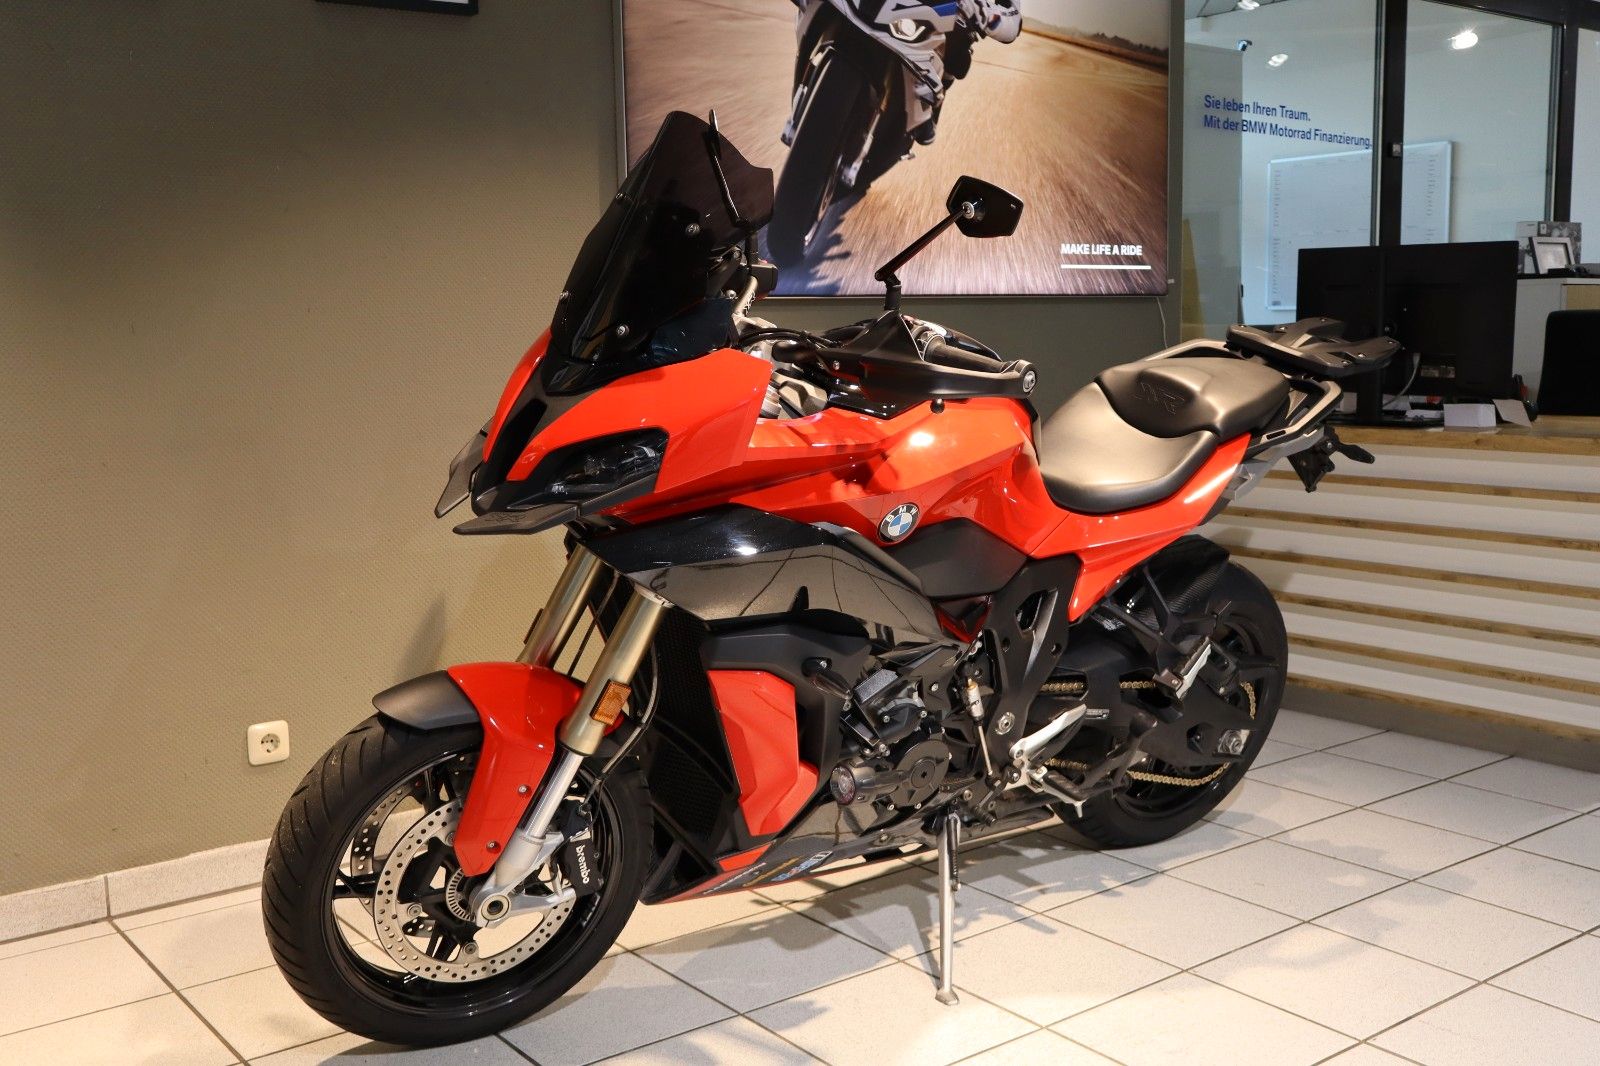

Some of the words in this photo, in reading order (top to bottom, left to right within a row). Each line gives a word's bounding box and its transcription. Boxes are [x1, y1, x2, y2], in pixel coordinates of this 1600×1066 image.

[1204, 94, 1221, 110] Sie
[1223, 97, 1250, 114] leben
[1252, 101, 1277, 117] Ihren
[1279, 105, 1311, 122] Traum.
[1204, 114, 1220, 129] Mit
[1223, 116, 1240, 131] der
[1241, 119, 1268, 135] BMW
[1269, 123, 1312, 140] Motorrad
[1314, 128, 1373, 150] Finanzierung.
[1060, 243, 1090, 255] MAKE
[1091, 244, 1112, 255] LIFE
[1112, 244, 1120, 256] A
[1120, 245, 1143, 256] RIDE
[575, 844, 591, 884] brembo
